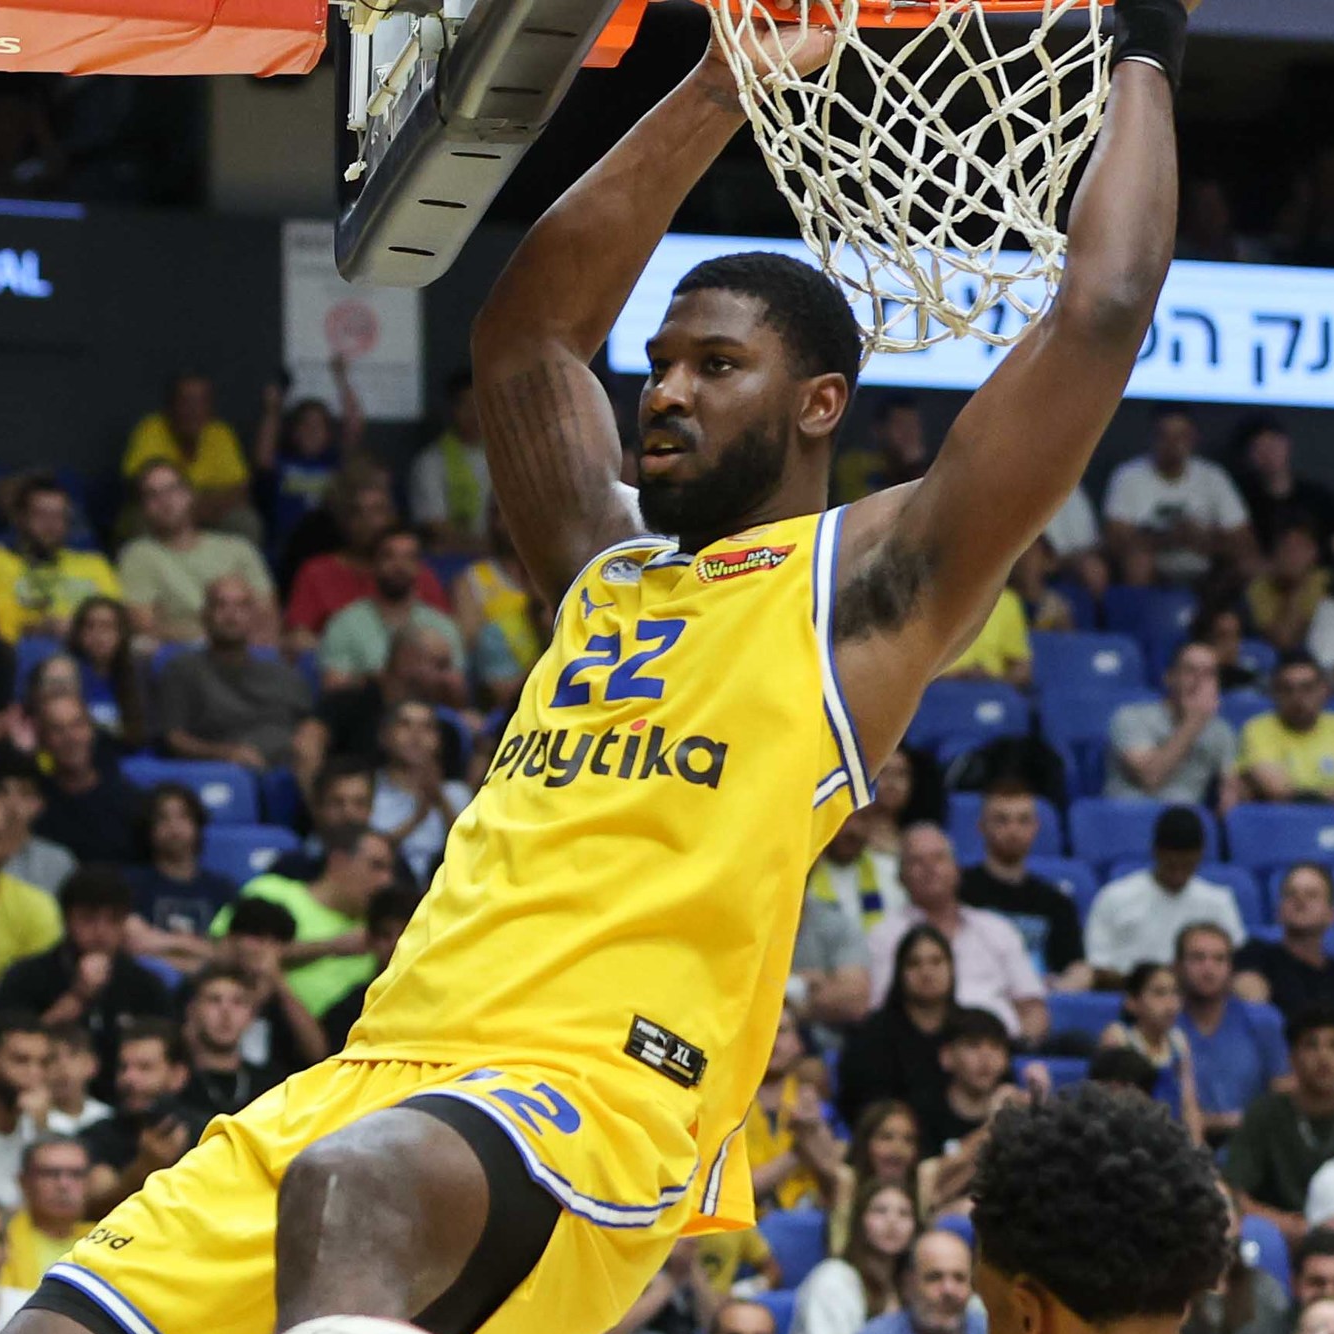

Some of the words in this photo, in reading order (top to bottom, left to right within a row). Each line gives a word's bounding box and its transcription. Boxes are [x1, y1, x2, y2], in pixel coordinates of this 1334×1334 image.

[549, 619, 686, 709] 22
[484, 718, 729, 790] playtika
[671, 1043, 691, 1068] XL
